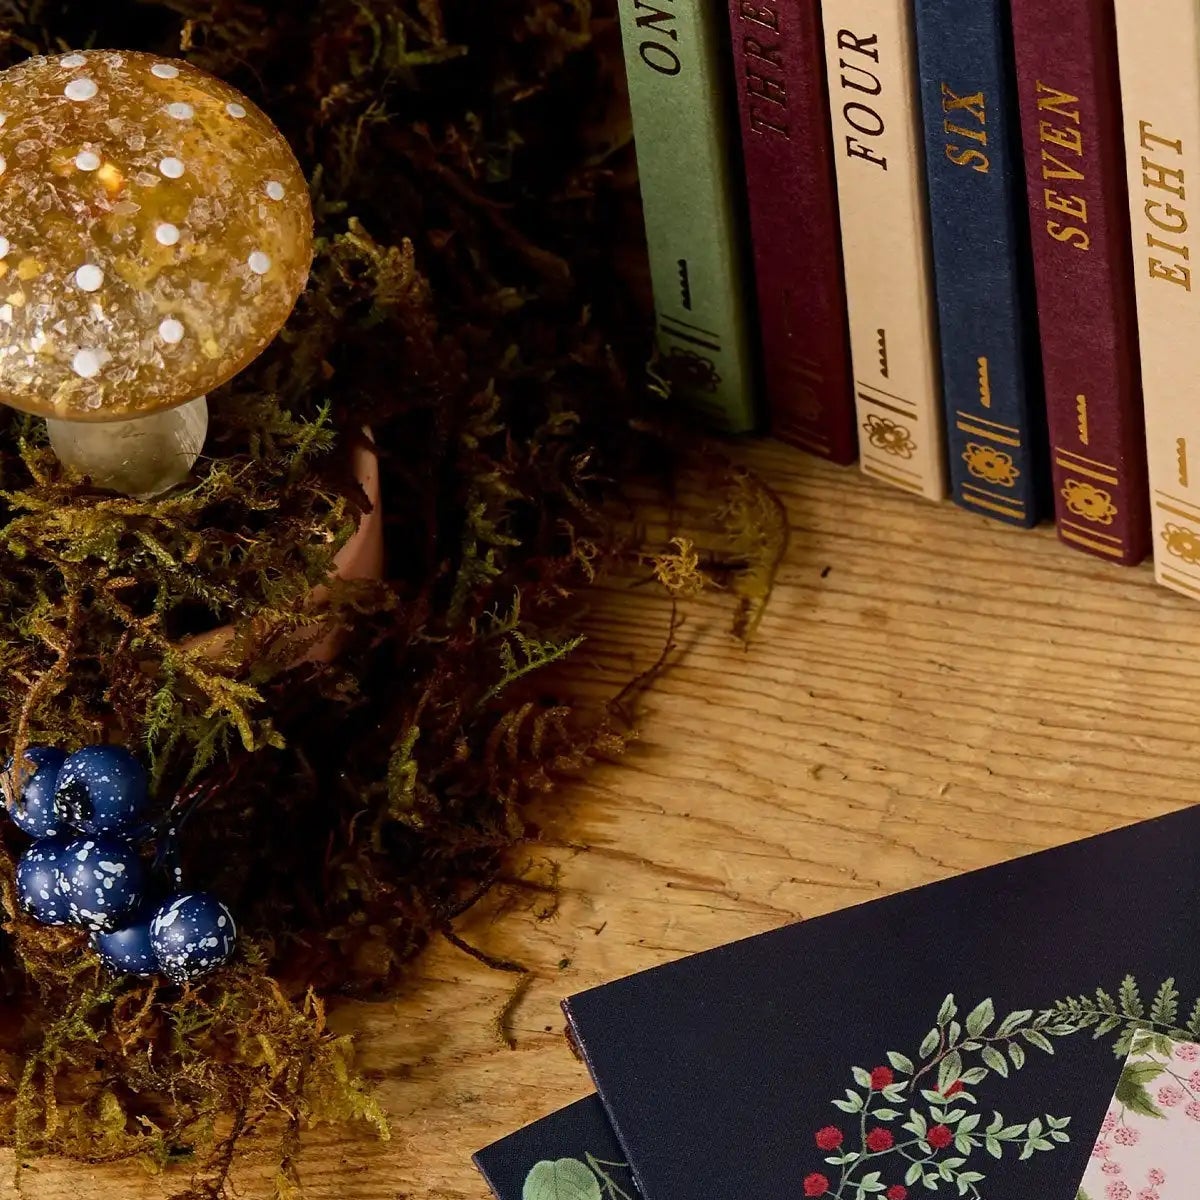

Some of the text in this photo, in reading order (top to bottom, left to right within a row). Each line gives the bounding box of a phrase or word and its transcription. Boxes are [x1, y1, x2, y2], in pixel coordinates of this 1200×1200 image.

[634, 0, 681, 76] ON
[739, 0, 791, 140] THRE
[837, 28, 888, 171] FOUR
[941, 82, 990, 173] SIX
[1035, 80, 1090, 250] SEVEN
[1138, 120, 1191, 291] EIGHT
